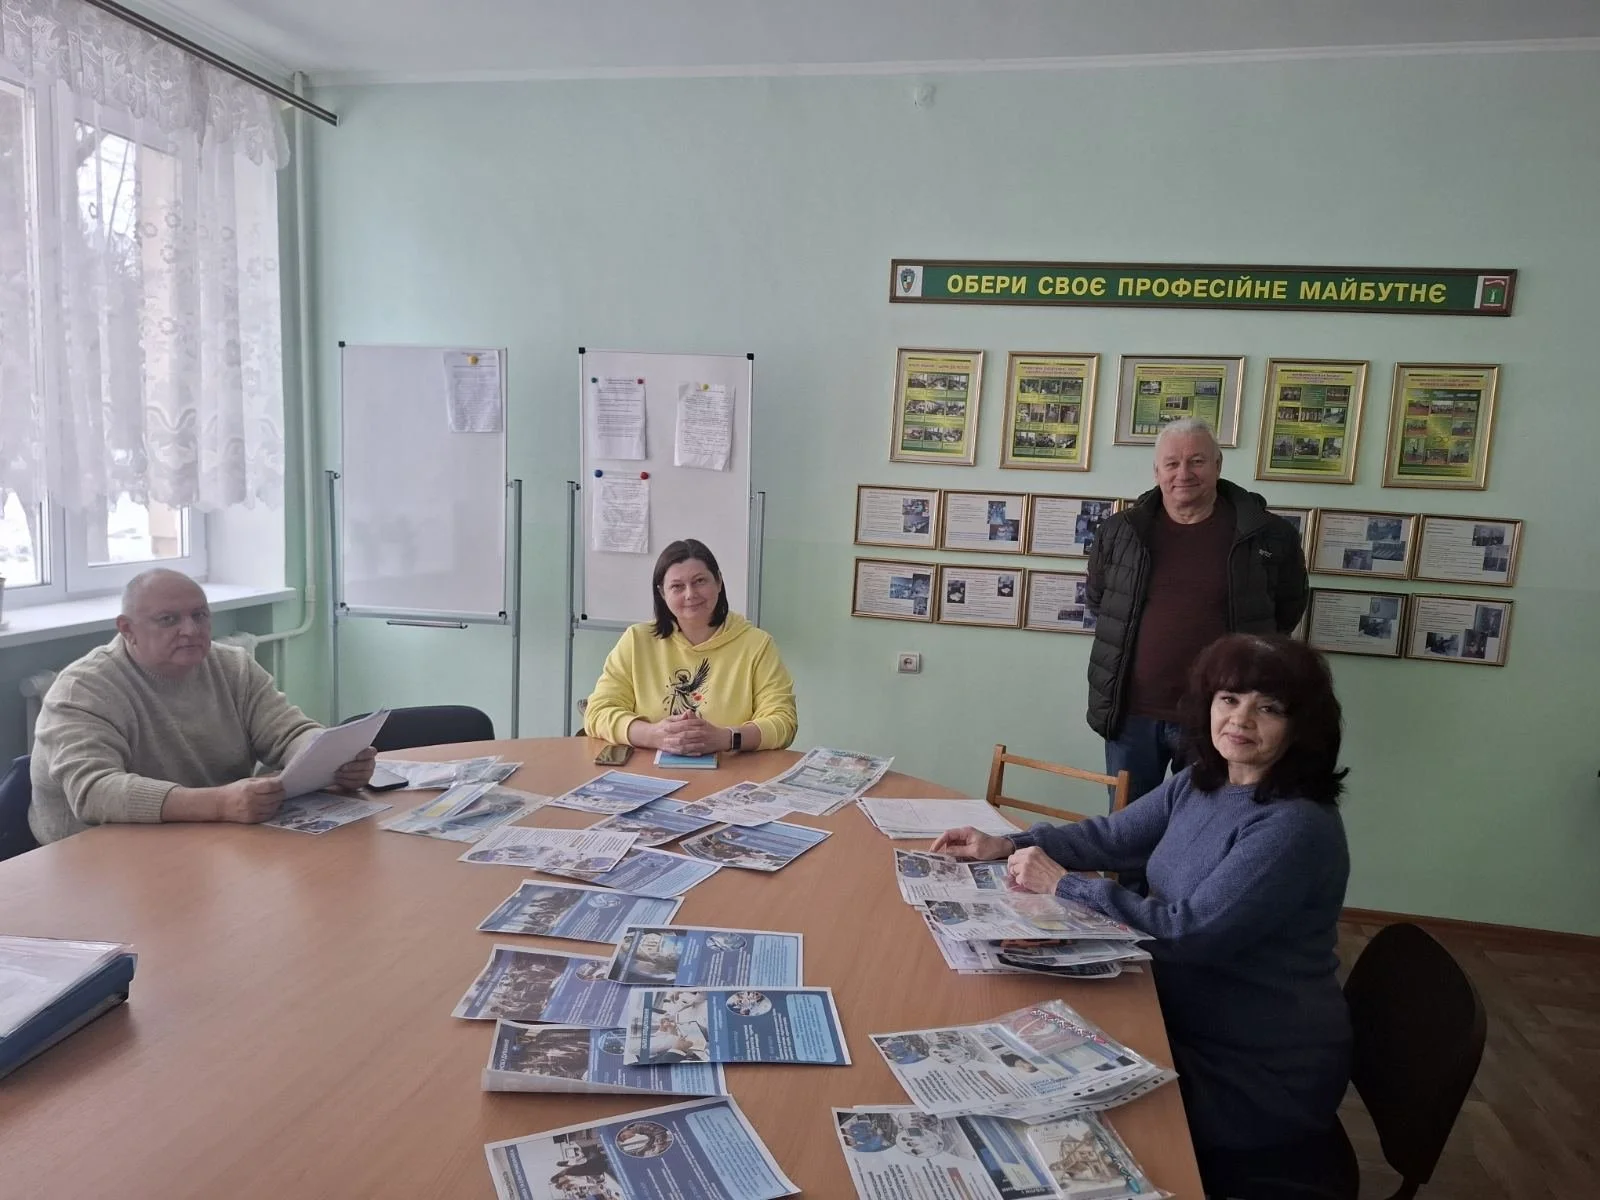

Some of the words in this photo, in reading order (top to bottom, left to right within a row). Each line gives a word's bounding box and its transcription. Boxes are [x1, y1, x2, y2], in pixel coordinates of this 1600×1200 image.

[947, 274, 1027, 294] ОБЕРИ
[1038, 276, 1106, 296] СВОЄ
[1117, 275, 1288, 299] ПРОФЕСІЙНЕ
[1299, 277, 1447, 303] МАЙБУТНЄ
